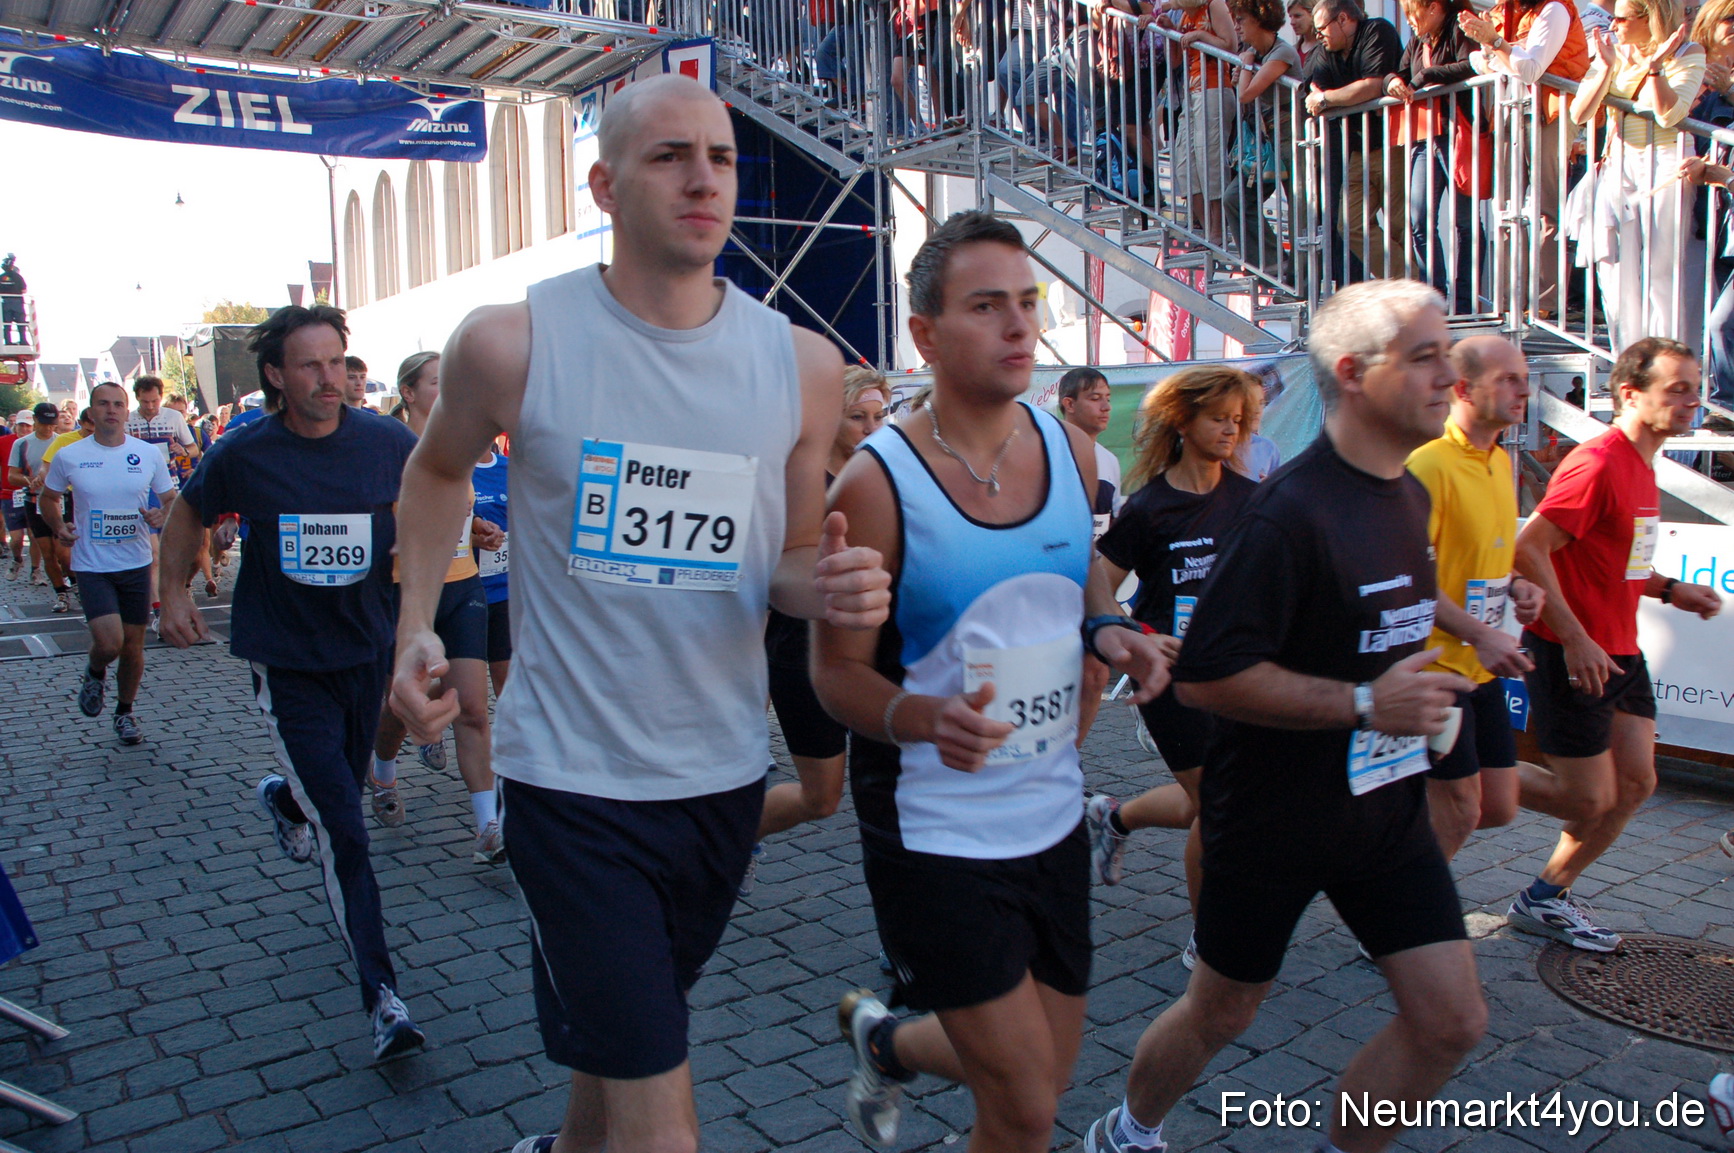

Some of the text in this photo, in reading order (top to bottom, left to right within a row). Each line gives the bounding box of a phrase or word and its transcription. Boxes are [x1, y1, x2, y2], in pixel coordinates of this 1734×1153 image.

[171, 84, 313, 135] ZIEL
[398, 139, 477, 147] www.mizunoeurope.com
[625, 459, 692, 490] Peter
[586, 493, 606, 515] B
[103, 513, 139, 521] Francesco
[104, 524, 137, 536] 2669
[302, 522, 349, 535] Johann
[622, 506, 736, 554] 3179
[285, 540, 295, 552] B
[304, 545, 366, 567] 2369
[571, 556, 637, 577] BOCK
[1179, 621, 1188, 631] C
[1008, 682, 1076, 729] 3587
